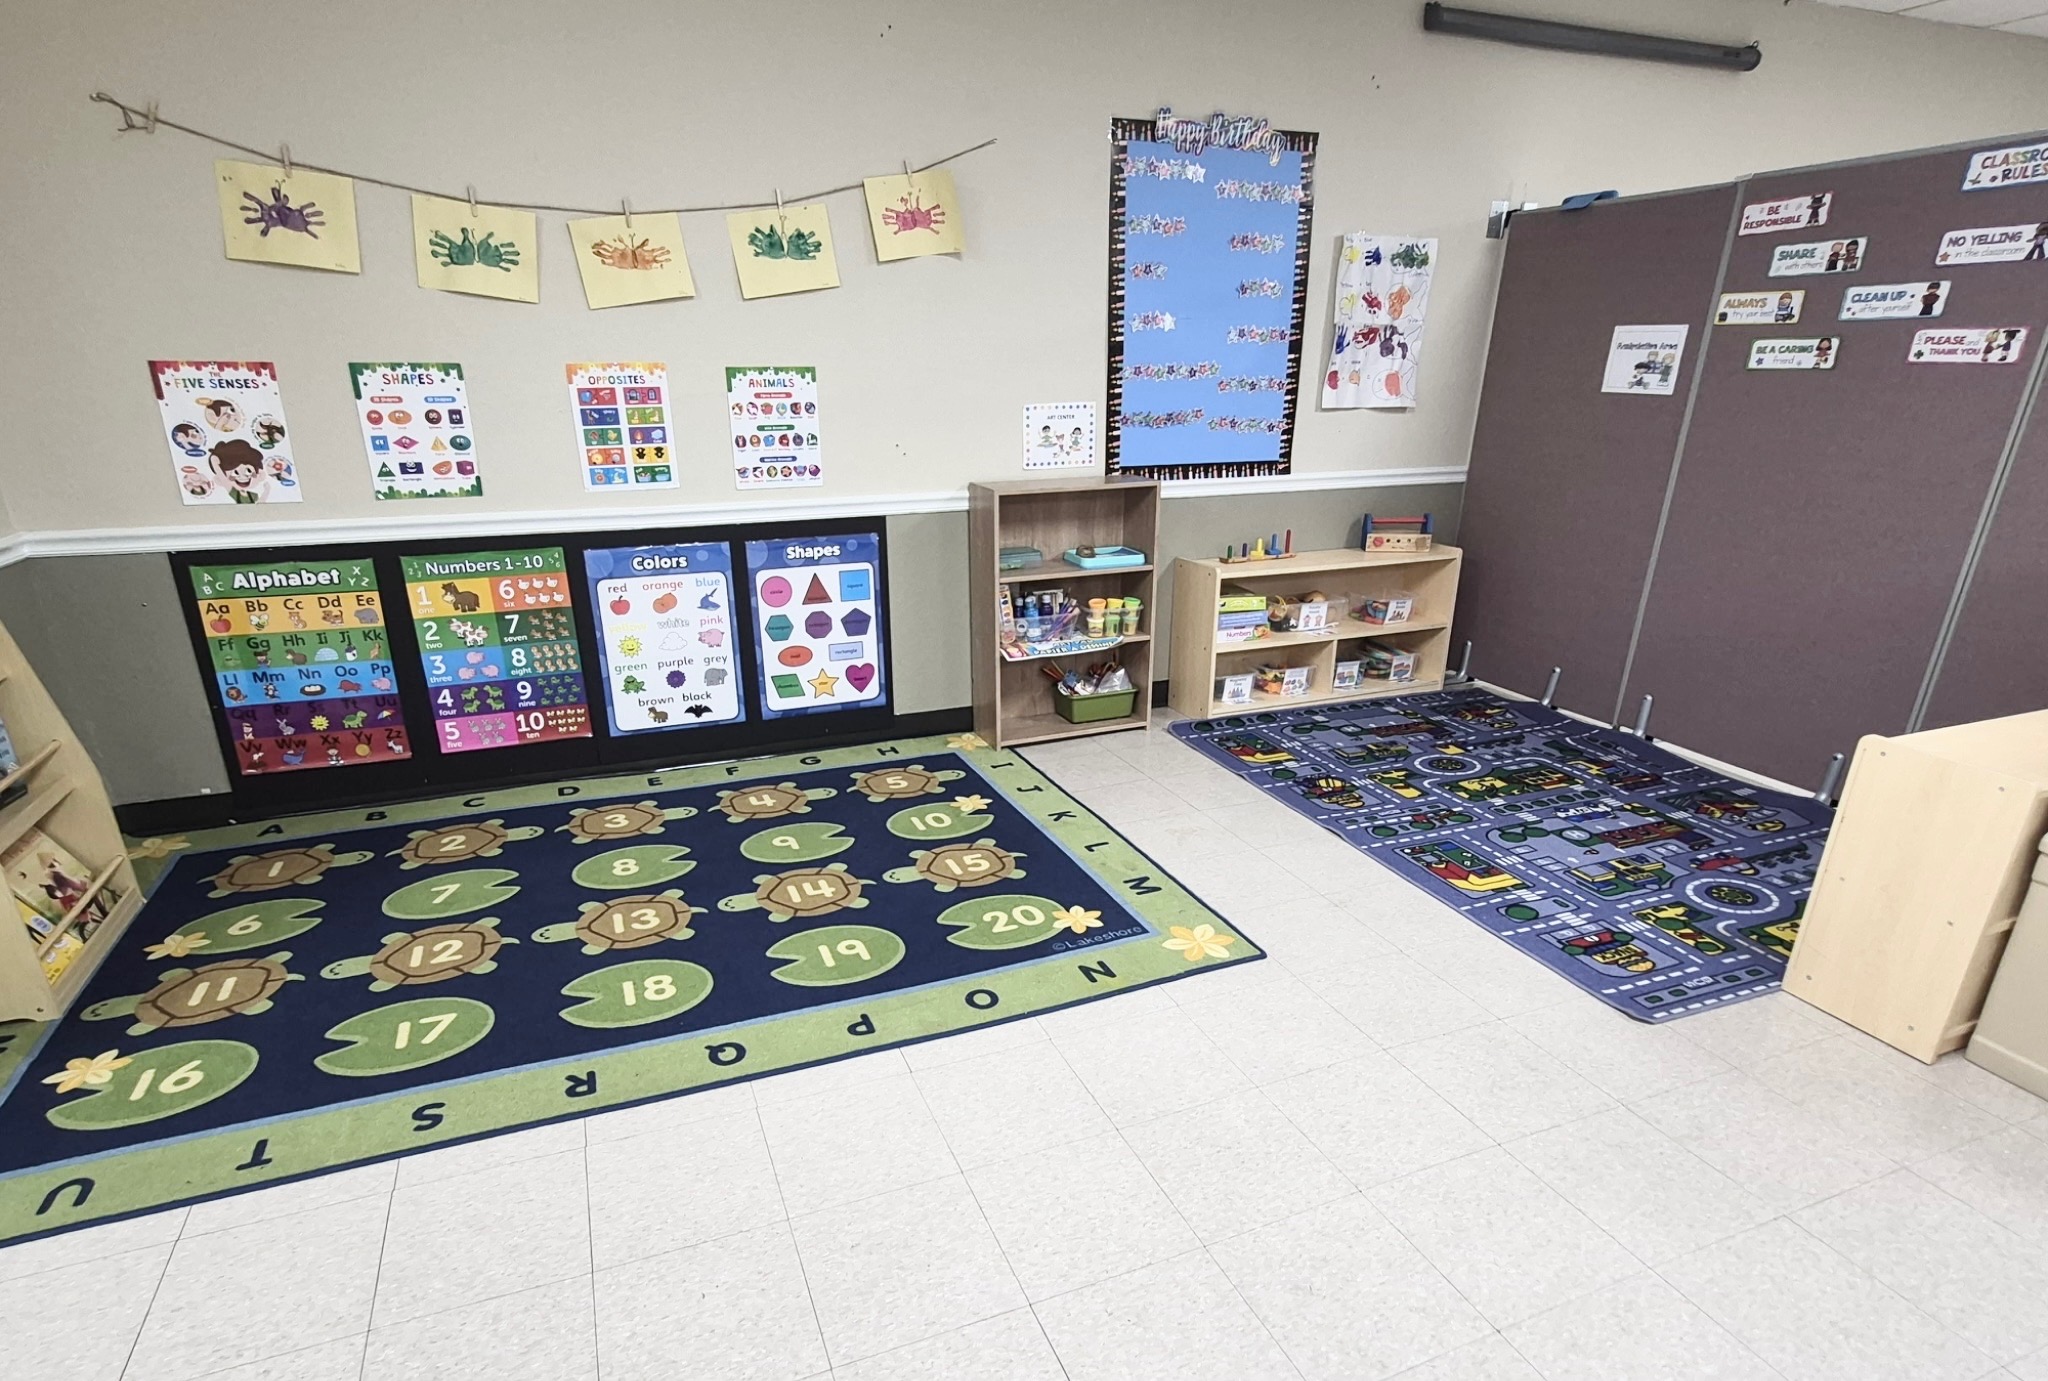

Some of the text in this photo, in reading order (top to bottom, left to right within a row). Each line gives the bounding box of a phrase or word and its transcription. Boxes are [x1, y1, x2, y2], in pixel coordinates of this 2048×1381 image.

[1157, 108, 1285, 166] Happy Birthday
[2000, 164, 2048, 182] RULES
[1767, 205, 1782, 216] BE
[1743, 214, 1802, 230] RESPONSIBLE
[1947, 231, 2023, 248] NO YELLING
[1777, 247, 1818, 261] SHARE
[1723, 297, 1767, 309] ALWAYS
[1850, 290, 1907, 304] CLEAN UP
[1924, 335, 1967, 346] PLEASE
[1755, 346, 1769, 354] BE
[1778, 344, 1814, 354] CARING
[1930, 346, 1981, 356] THANK YOU
[175, 377, 260, 389] FIVE SENSES
[382, 373, 434, 385] SHAPES
[587, 374, 646, 385] OPPOSITES
[749, 378, 795, 388] ANIMALS
[786, 544, 841, 560] Shapes
[353, 566, 361, 575] X
[425, 555, 543, 575] Numbers 1-10
[632, 554, 688, 571] Colors
[203, 572, 213, 583] A
[233, 569, 341, 591] Alphabet
[348, 577, 357, 587] Y
[361, 577, 370, 587] Z
[607, 577, 720, 593] red orange blue
[202, 585, 212, 595] B
[216, 581, 225, 591] C
[499, 579, 515, 600] 6
[416, 586, 432, 606] 1
[503, 600, 516, 608] six
[206, 594, 376, 615] Aa Bb Cc Dd Ee
[418, 606, 436, 614] one
[505, 614, 519, 634] 7
[657, 615, 724, 629] white pink
[423, 621, 440, 641] 2
[503, 634, 528, 643] seven
[217, 629, 383, 653] Ff Gg Hh Ii Jj Kk
[425, 641, 443, 649] two
[429, 655, 446, 674] 3
[511, 648, 527, 667] 8
[614, 654, 727, 675] green purple grey
[222, 663, 391, 686] Ll Mm Nn Oo Pp
[430, 674, 453, 683] three
[511, 667, 532, 676] eight
[437, 689, 454, 707] 4
[516, 681, 532, 700] 9
[638, 690, 712, 707] brown black
[374, 696, 397, 707] Uu
[518, 699, 536, 707] nine
[439, 708, 457, 716] four
[516, 712, 545, 732] 10
[443, 722, 460, 740] 5
[526, 731, 540, 739] ten
[240, 728, 404, 753] Vv Ww Xx Yy Zz
[447, 740, 463, 748] five
[257, 746, 900, 837] A B C D E F G H
[268, 776, 909, 877] 1 2 3 4 5
[990, 762, 1163, 896] I J K L M
[228, 812, 953, 935] 6 7 8 9 10
[187, 853, 991, 1007] 11 12 13 14 15
[129, 905, 1046, 1101] 16 17 18 19 20
[36, 961, 1118, 1215] N O P Q R S T U
